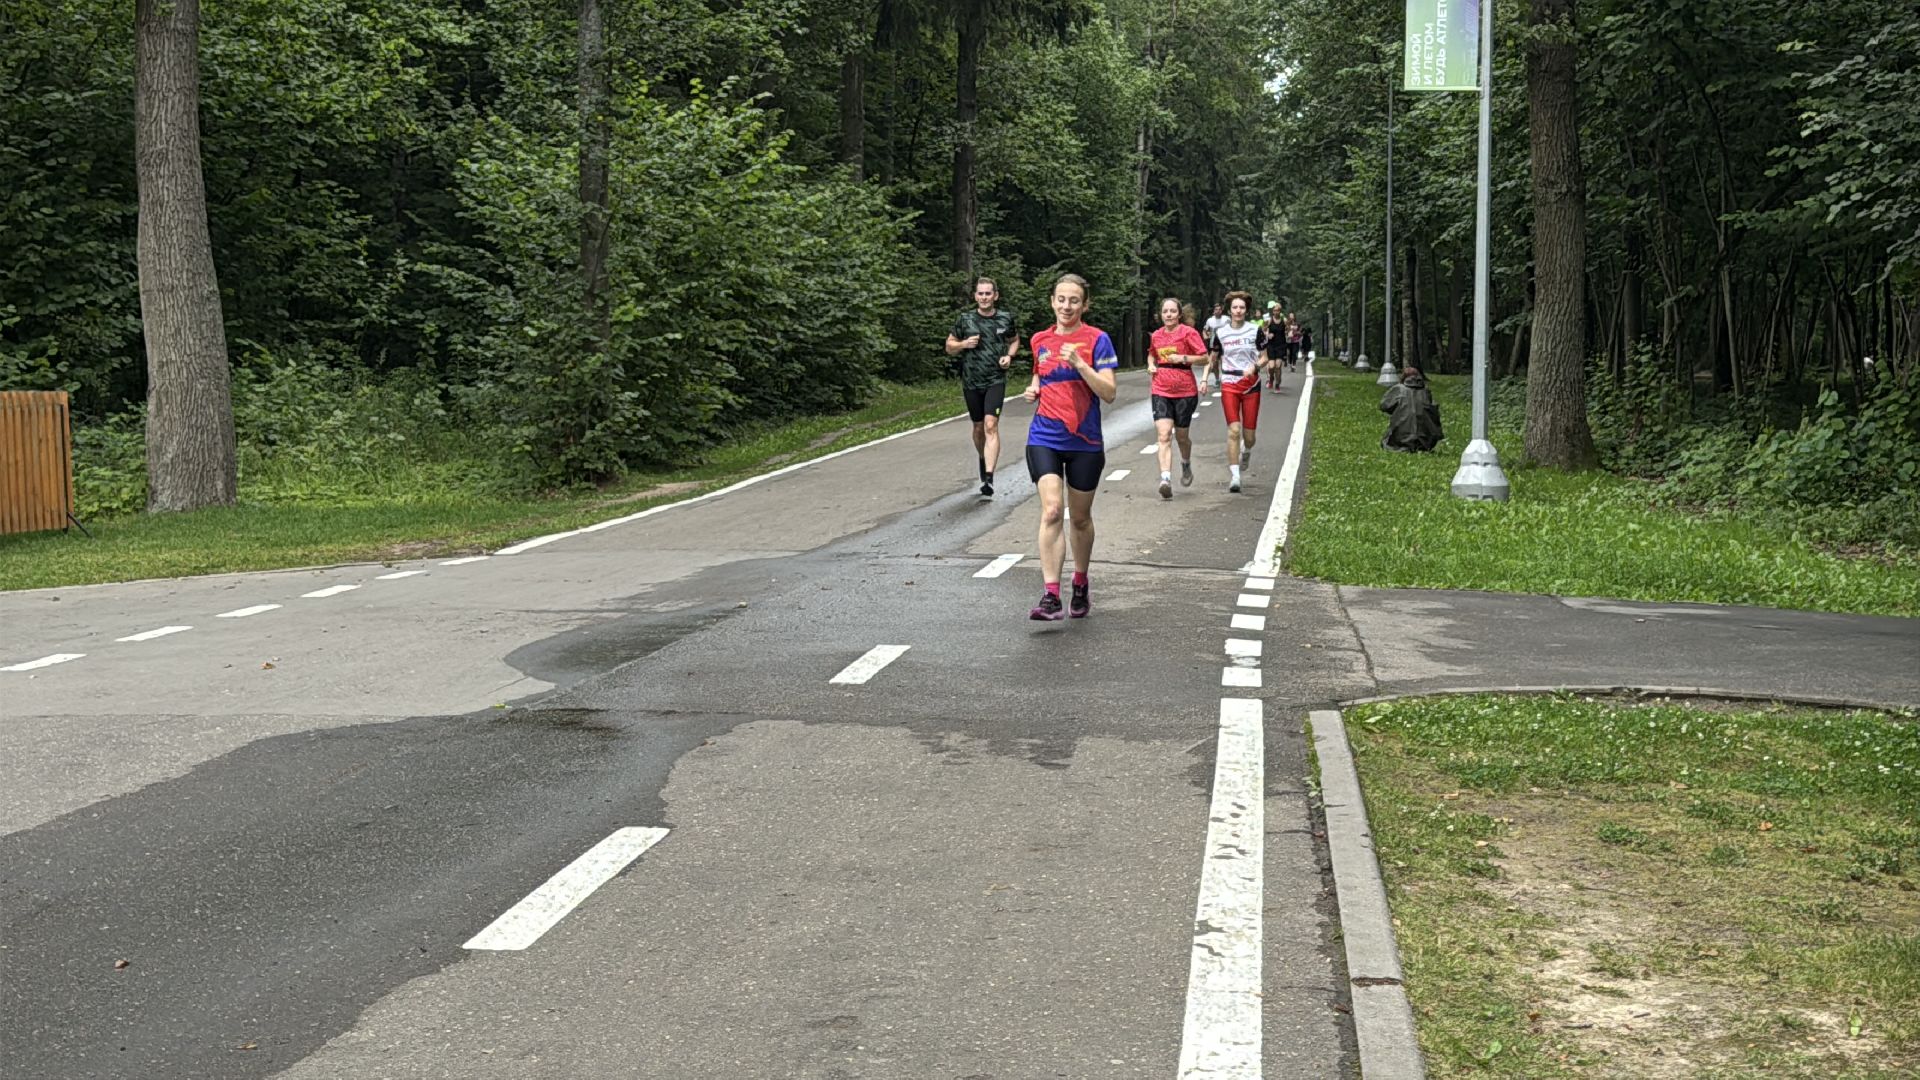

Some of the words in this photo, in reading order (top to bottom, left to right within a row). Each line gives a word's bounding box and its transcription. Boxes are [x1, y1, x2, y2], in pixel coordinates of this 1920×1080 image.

[1437, 0, 1447, 45] АТЛЕТ
[1409, 33, 1422, 85] ЗИМОЙ
[1424, 22, 1434, 70] ЛЕТОМ
[1437, 48, 1447, 85] БУДЬ
[1424, 74, 1433, 85] И
